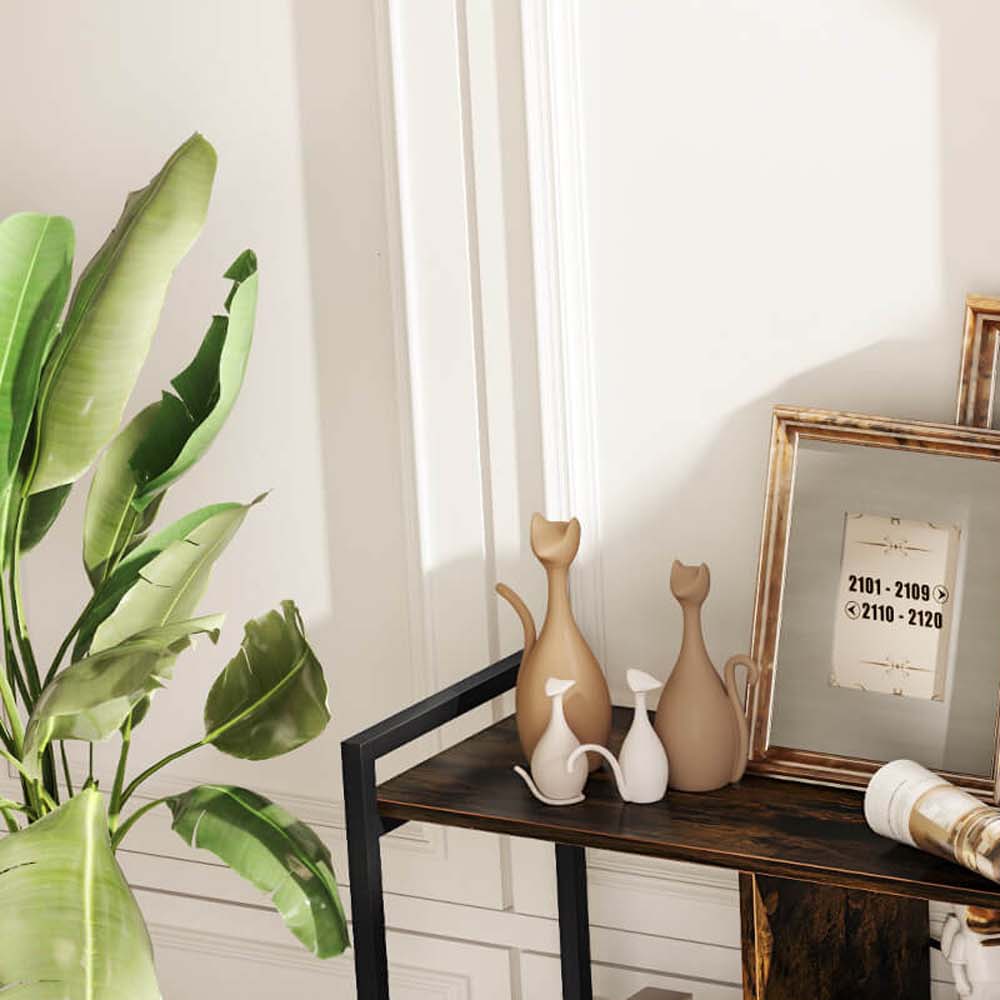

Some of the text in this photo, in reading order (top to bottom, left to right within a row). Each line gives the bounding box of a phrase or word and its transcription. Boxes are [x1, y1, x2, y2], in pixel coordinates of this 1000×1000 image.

[848, 575, 881, 597] 2101
[895, 580, 931, 602] 2109
[861, 603, 895, 623] 2110
[908, 608, 943, 629] 2120
